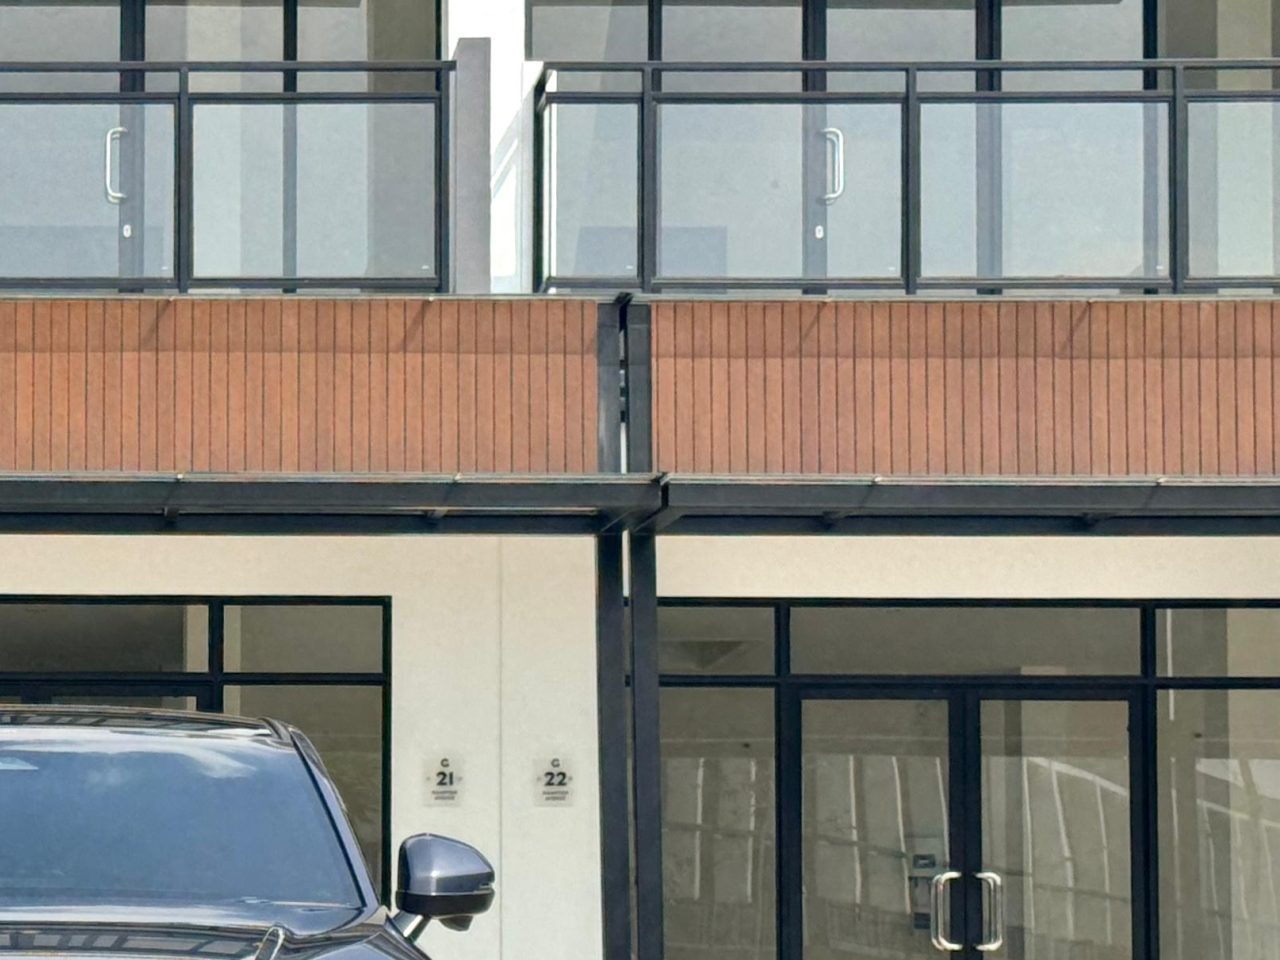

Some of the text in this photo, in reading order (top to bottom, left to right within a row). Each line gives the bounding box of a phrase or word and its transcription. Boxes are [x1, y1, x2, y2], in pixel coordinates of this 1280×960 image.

[440, 758, 450, 768] G
[436, 771, 454, 786] 21
[544, 771, 567, 786] 22
